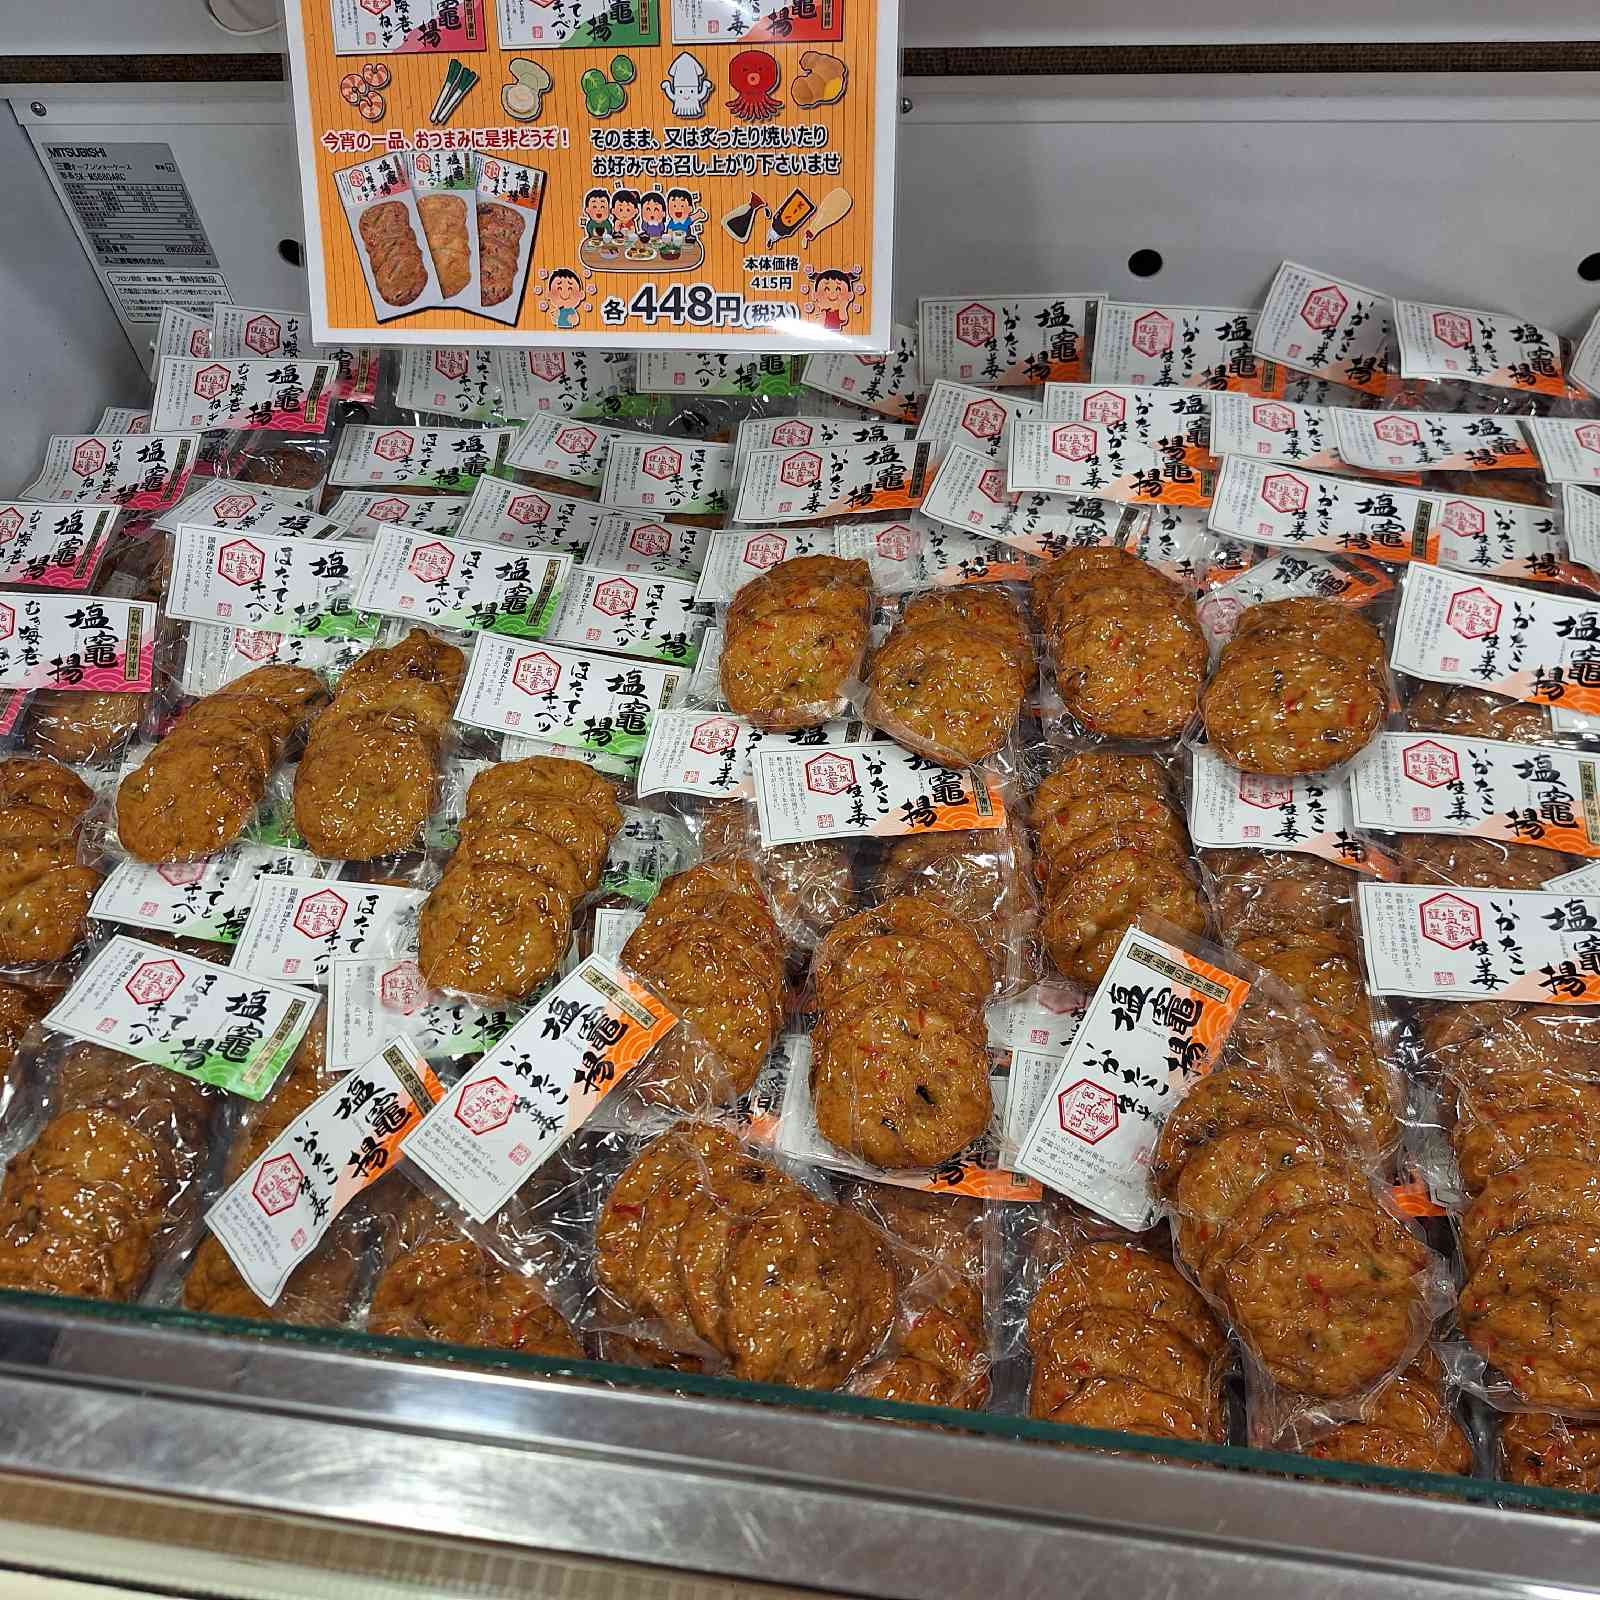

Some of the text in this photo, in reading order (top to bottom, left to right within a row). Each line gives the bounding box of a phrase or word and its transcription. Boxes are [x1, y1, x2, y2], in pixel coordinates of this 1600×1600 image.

[323, 129, 570, 150] 今宵の一品、おつまみに是非どうぞ！
[591, 127, 827, 148] そのまま、又は炙ったり焼いたり
[592, 155, 840, 175] お好みでお召し上がり下さいませ
[745, 257, 800, 271] 本体価格
[751, 277, 792, 290] 415円
[47, 602, 119, 685] 塩竈揚
[578, 669, 651, 747] 塩竈揚
[846, 784, 877, 828] 生姜
[863, 750, 892, 814] いかたこ
[1445, 779, 1480, 825] 生姜
[1468, 748, 1495, 816] いかたこ
[1504, 753, 1579, 841] 塩竈揚
[1490, 899, 1526, 976] いかたこ
[1469, 940, 1509, 991] 生姜
